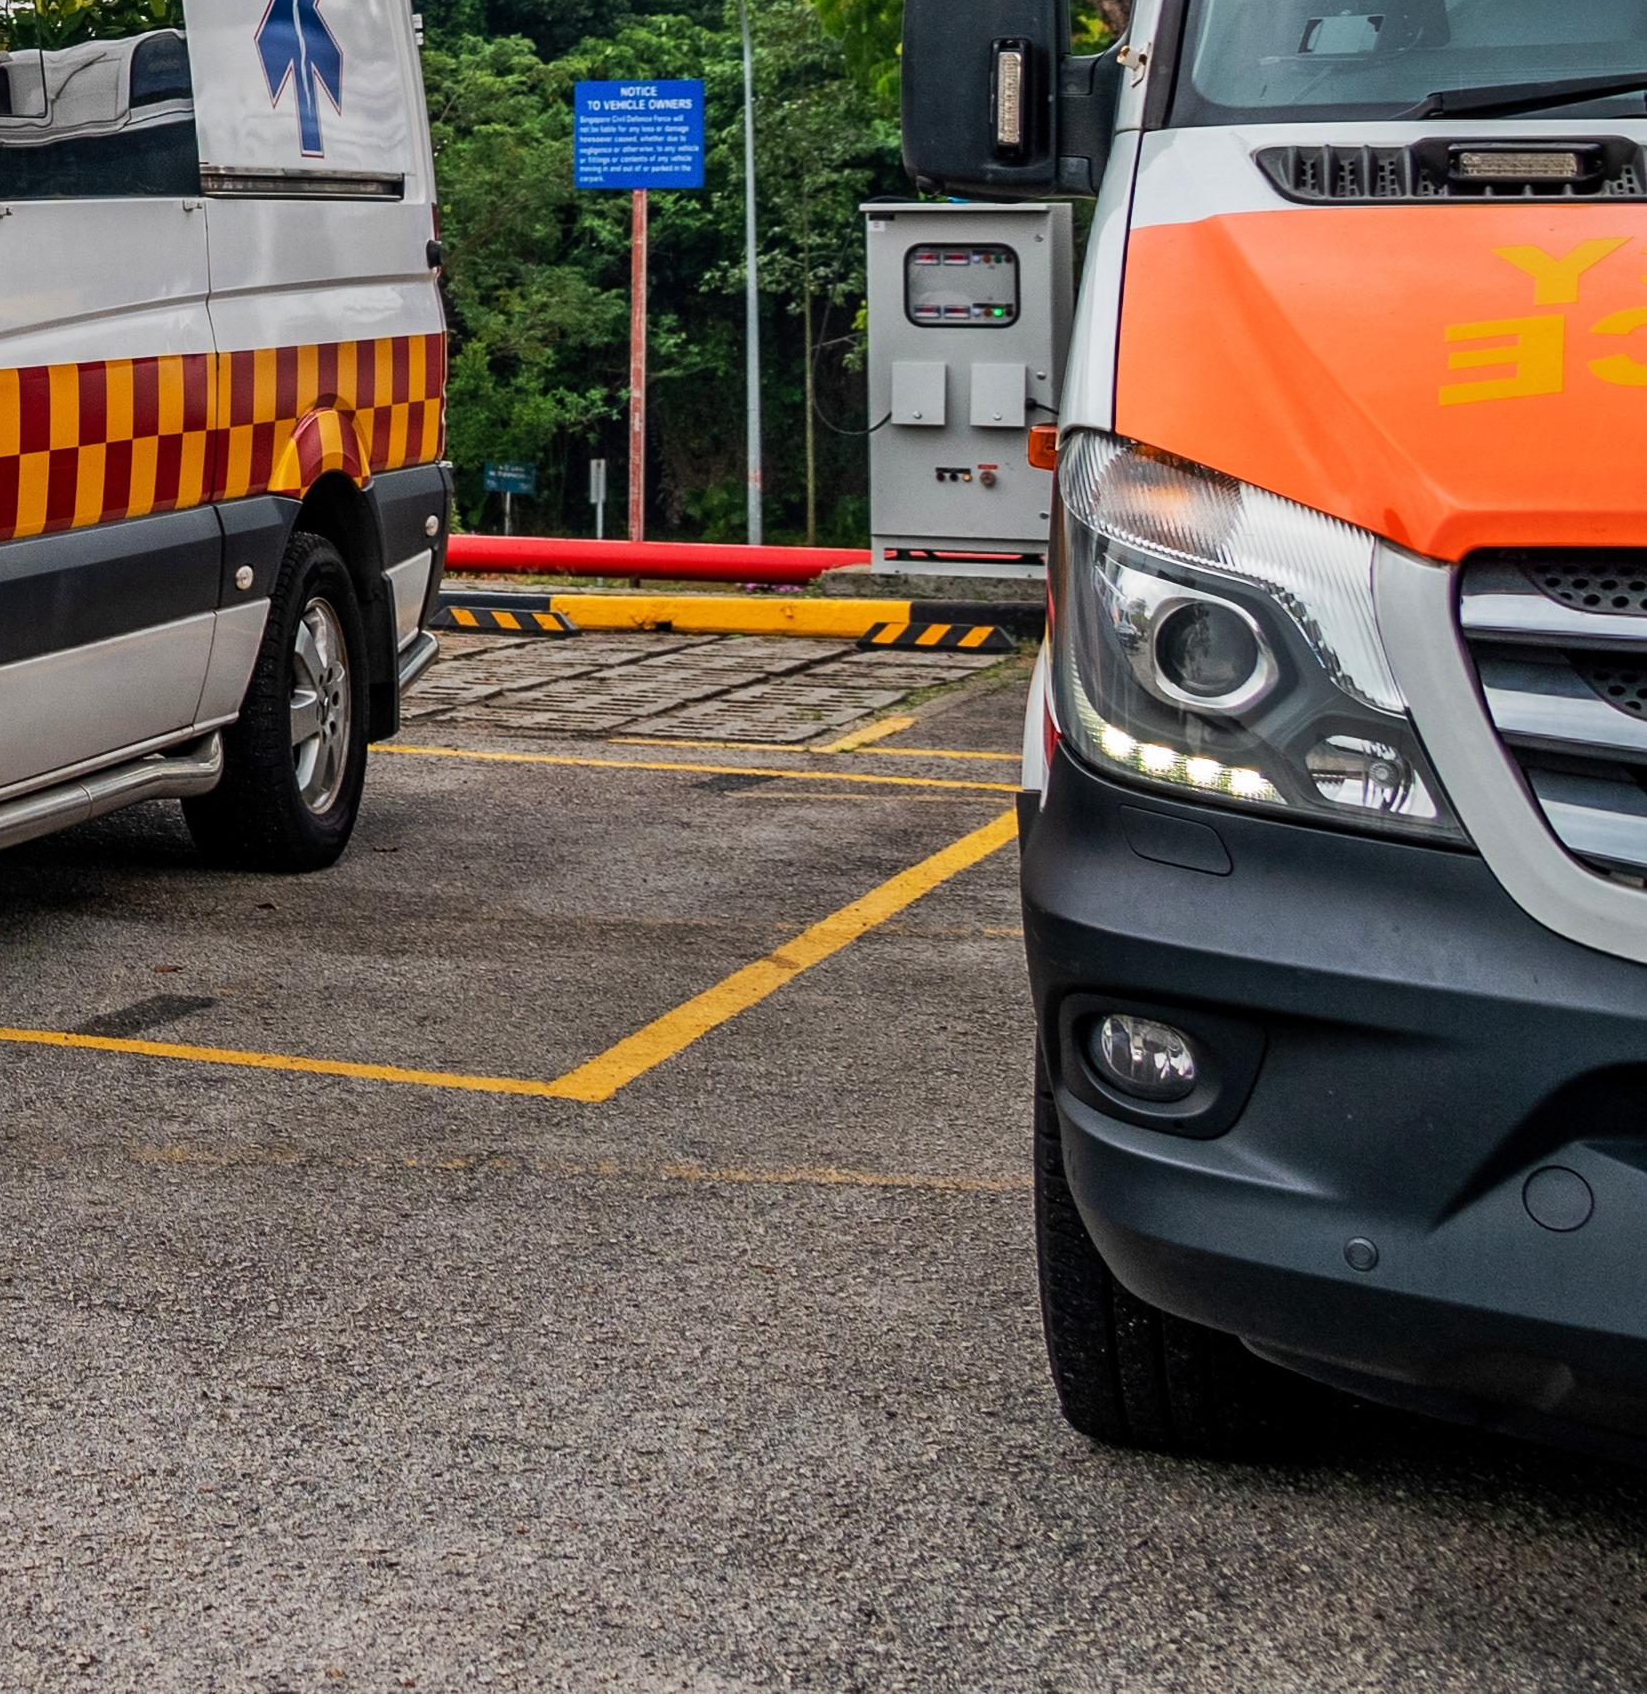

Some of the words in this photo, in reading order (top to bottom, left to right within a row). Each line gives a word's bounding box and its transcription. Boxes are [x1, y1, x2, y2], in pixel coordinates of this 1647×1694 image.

[620, 86, 658, 97] NOTICE
[587, 100, 601, 111] TO
[603, 99, 646, 111] VEHICLE
[648, 98, 693, 110] OWNERS
